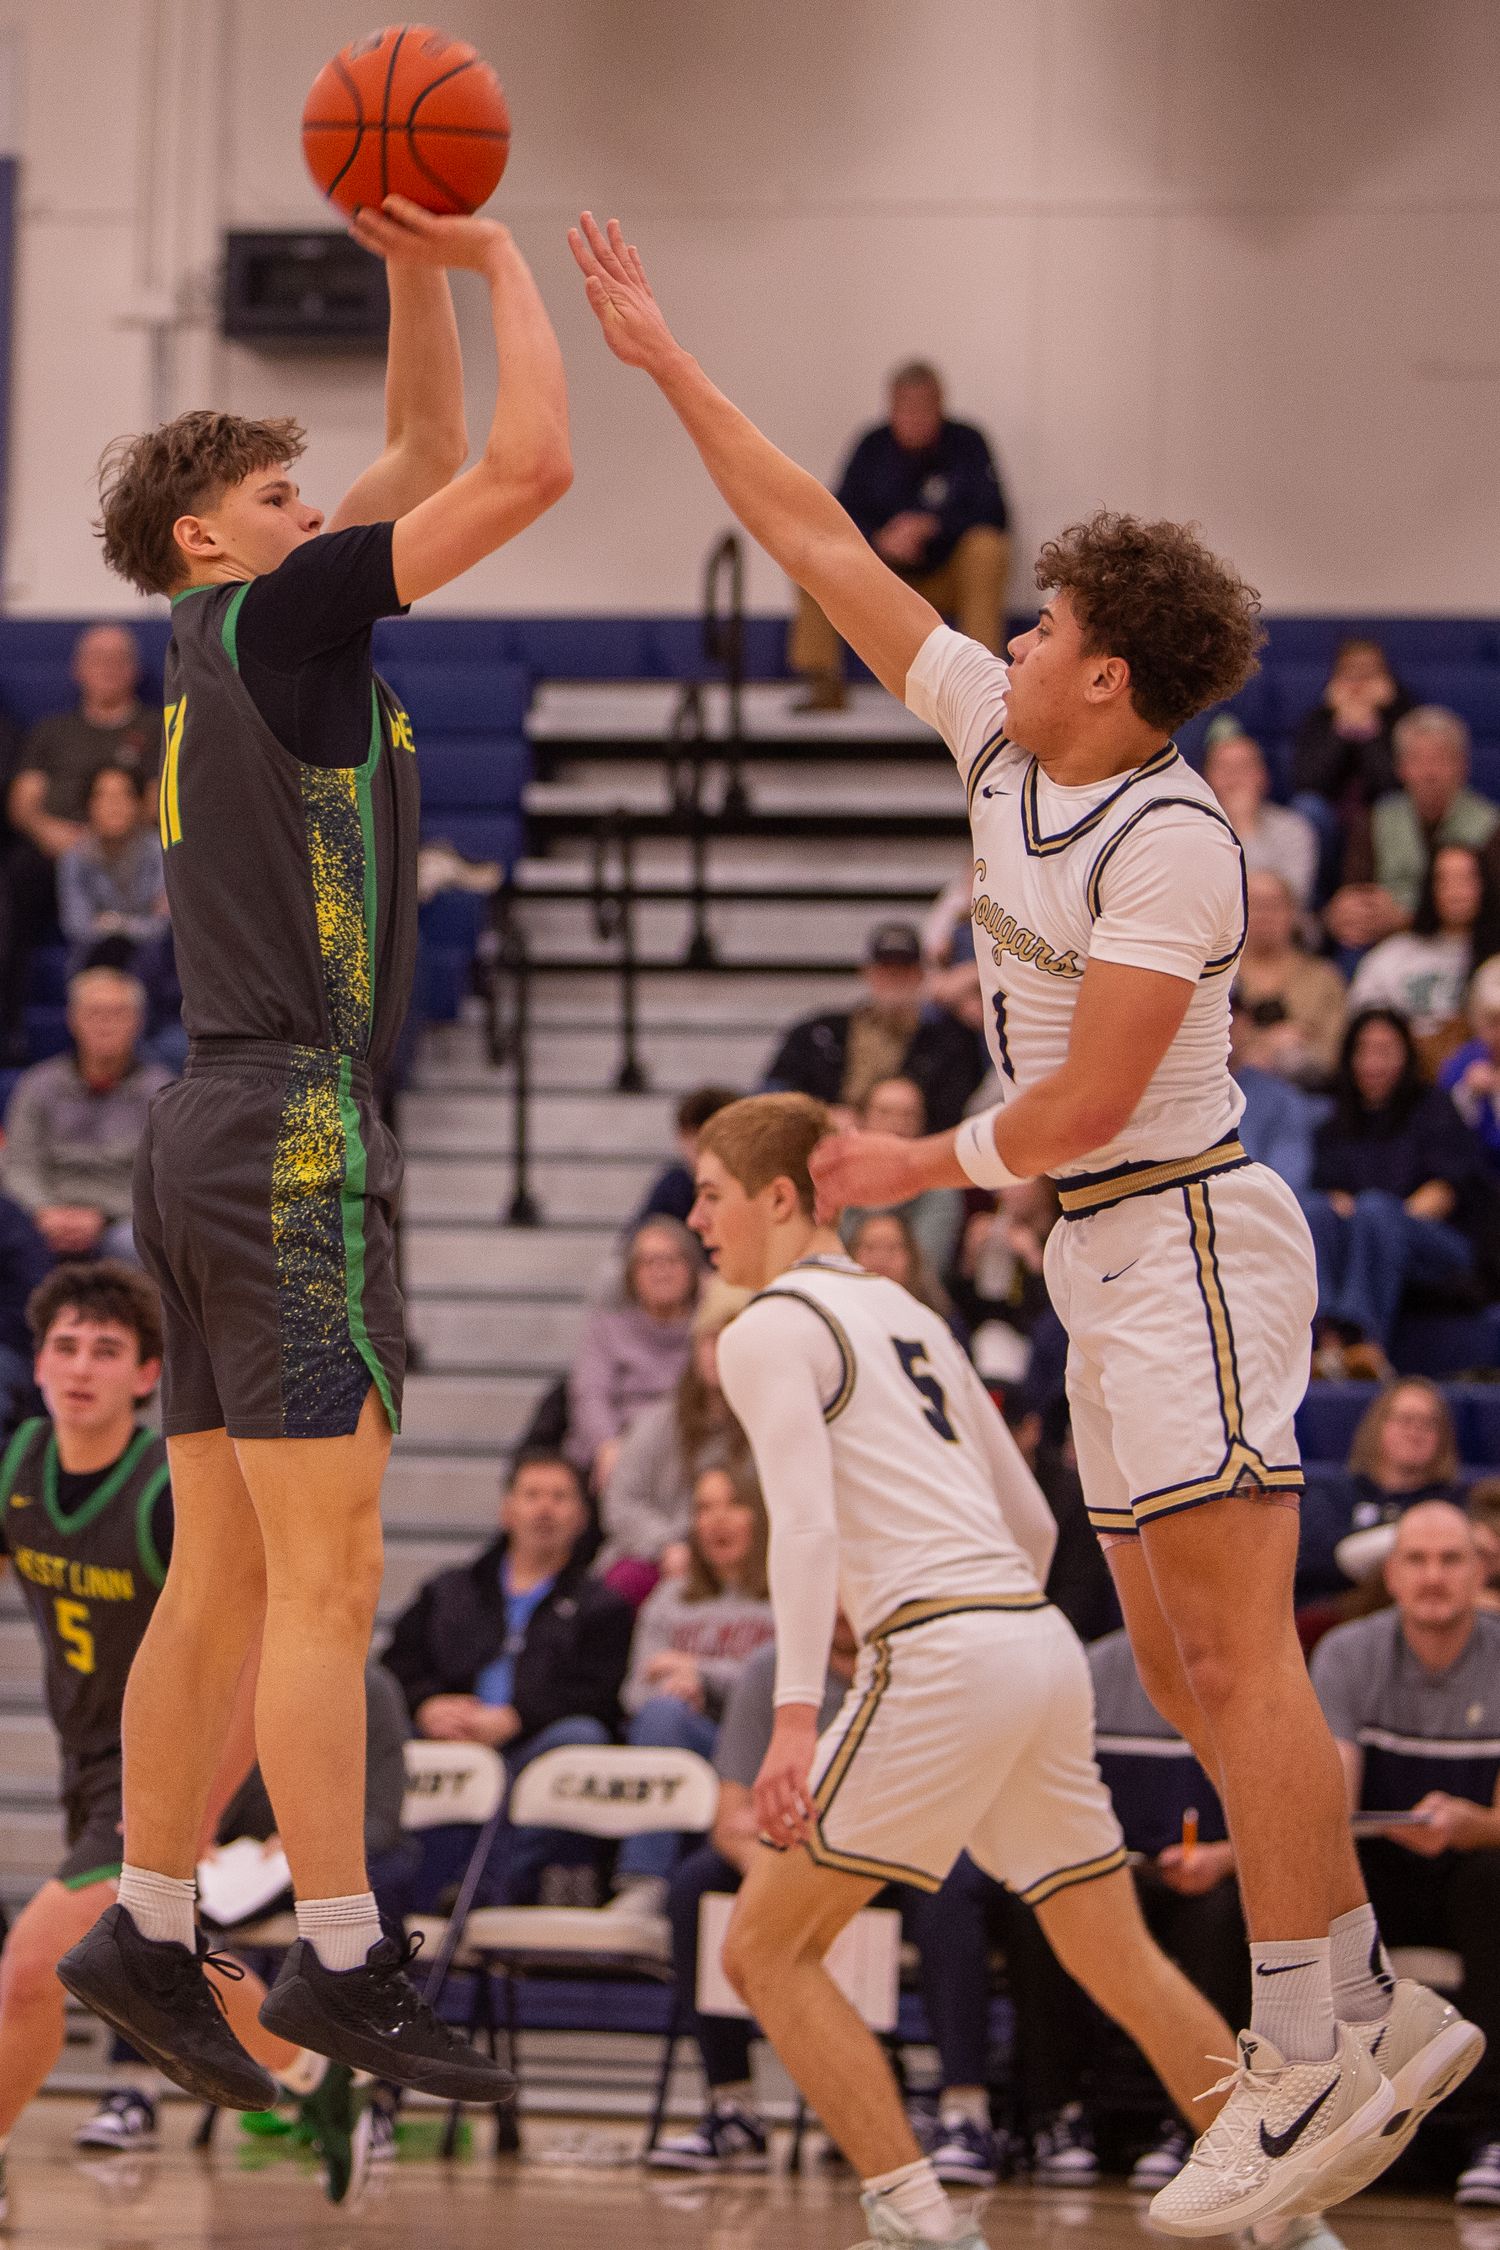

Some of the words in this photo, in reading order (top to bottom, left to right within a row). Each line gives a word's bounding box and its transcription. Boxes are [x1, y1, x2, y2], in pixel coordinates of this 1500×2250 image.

[385, 706, 416, 753] WE
[992, 990, 1016, 1085] 1
[890, 1336, 961, 1444] 5
[54, 1597, 95, 1675] 5
